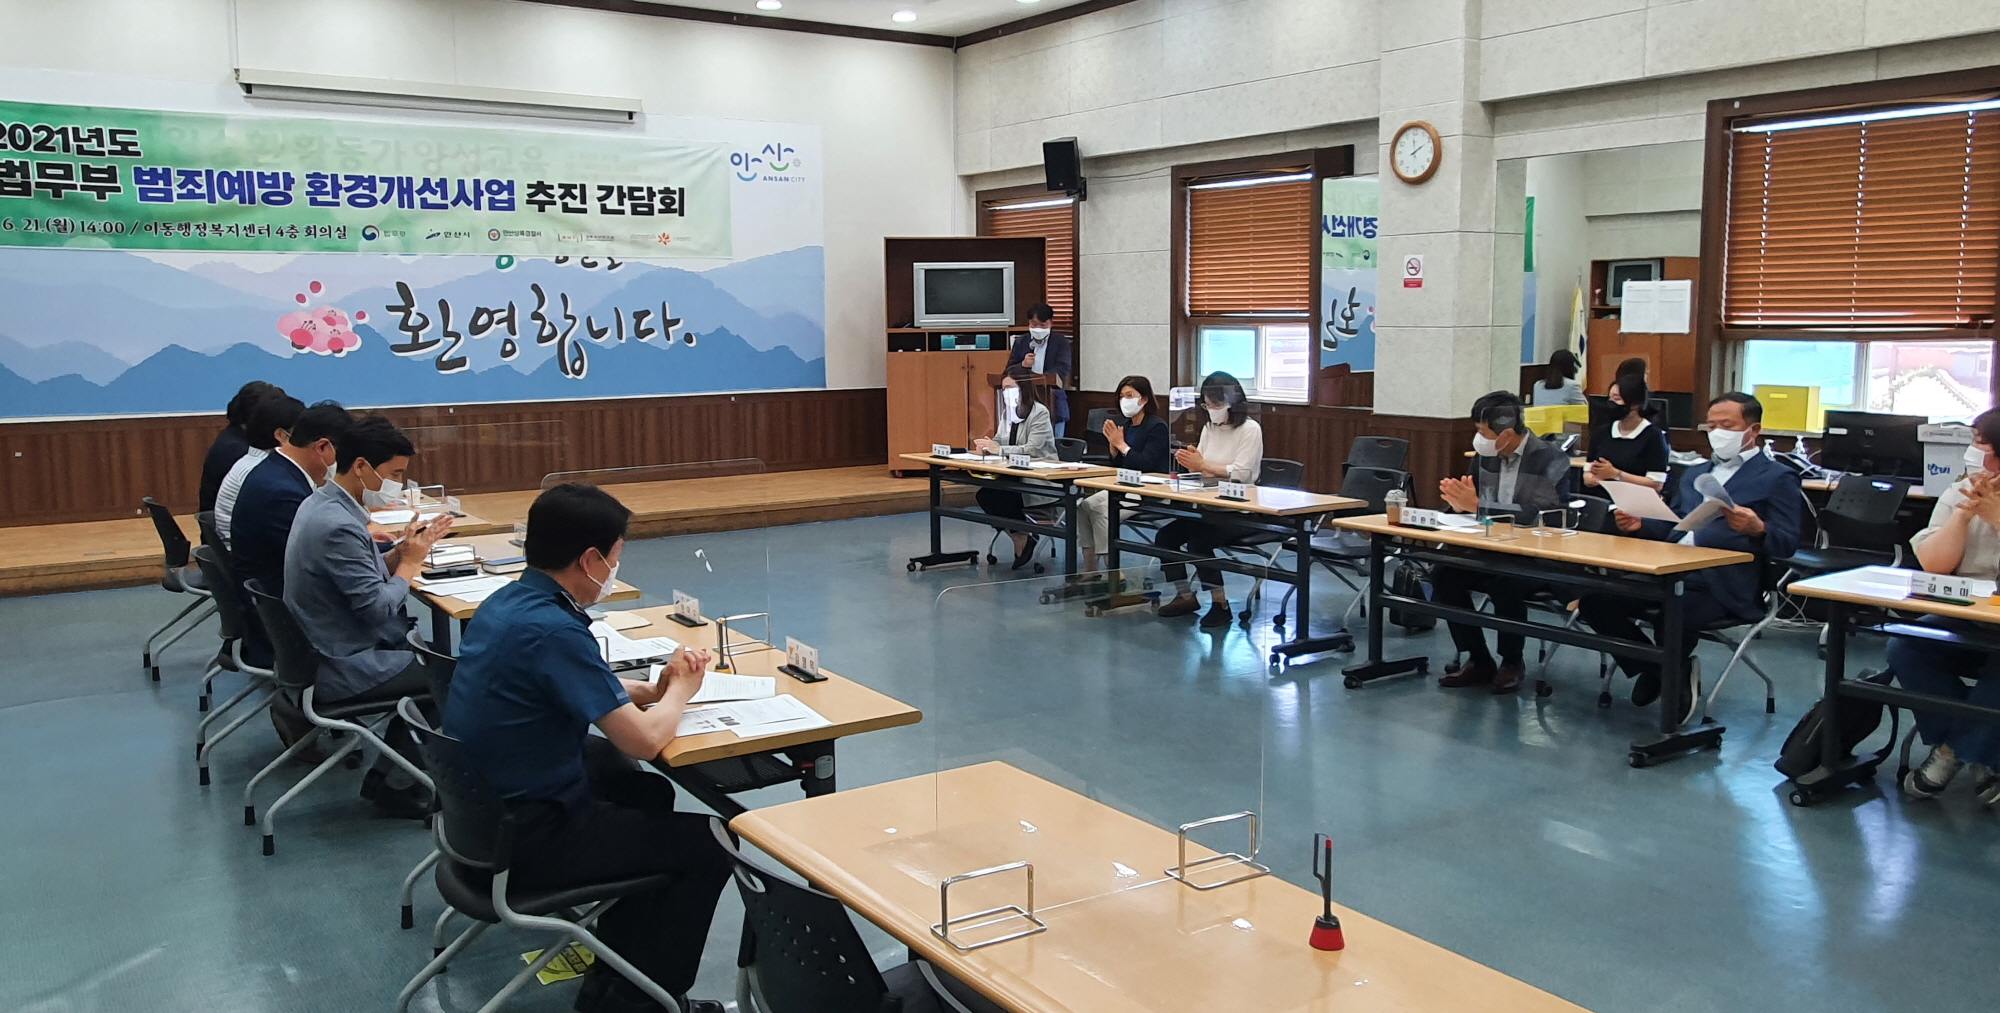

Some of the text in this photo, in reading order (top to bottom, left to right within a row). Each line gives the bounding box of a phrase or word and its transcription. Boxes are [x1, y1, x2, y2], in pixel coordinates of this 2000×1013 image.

[133, 166, 296, 206] 범죄예방
[305, 172, 516, 212] 환경개선사업
[525, 180, 588, 214] 추진
[596, 184, 685, 217] 간담회
[80, 220, 125, 234] 14:00
[143, 221, 271, 239] 이동행정복지센터
[275, 225, 300, 239] 4층
[304, 225, 348, 240] 회의실
